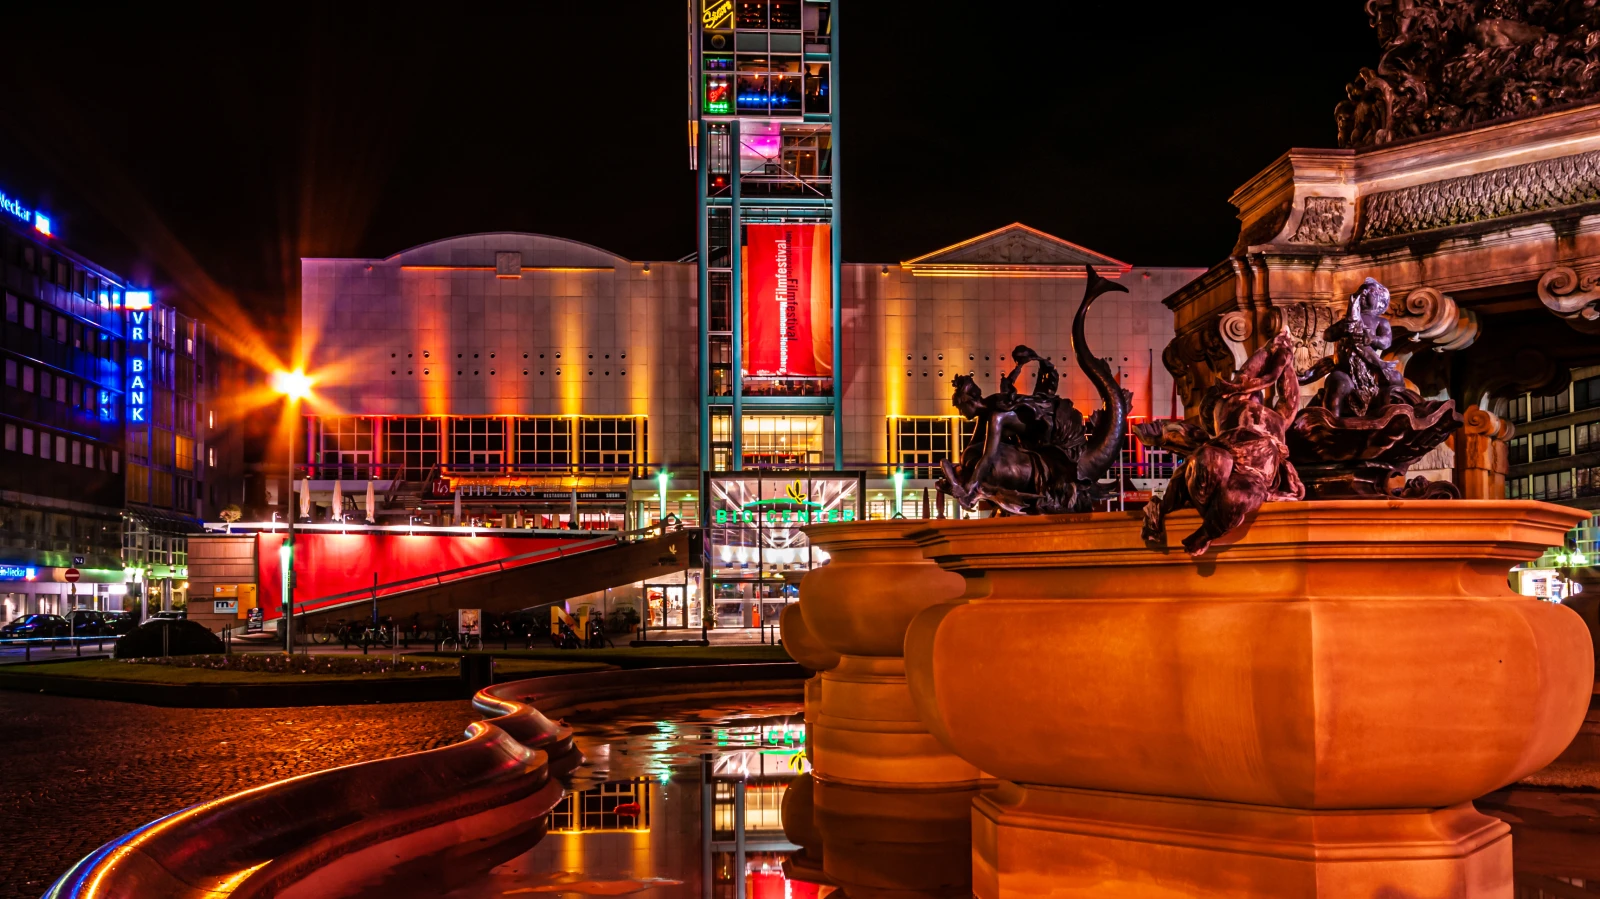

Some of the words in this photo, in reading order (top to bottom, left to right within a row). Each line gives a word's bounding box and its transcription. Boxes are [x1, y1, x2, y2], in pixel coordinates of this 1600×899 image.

[775, 240, 787, 301] Filmfestival
[132, 311, 144, 340] VR
[786, 278, 798, 341] Filmfestival
[131, 359, 144, 421] BANK
[459, 485, 493, 497] THE
[716, 509, 753, 523] BIO
[766, 509, 854, 523] CENTER
